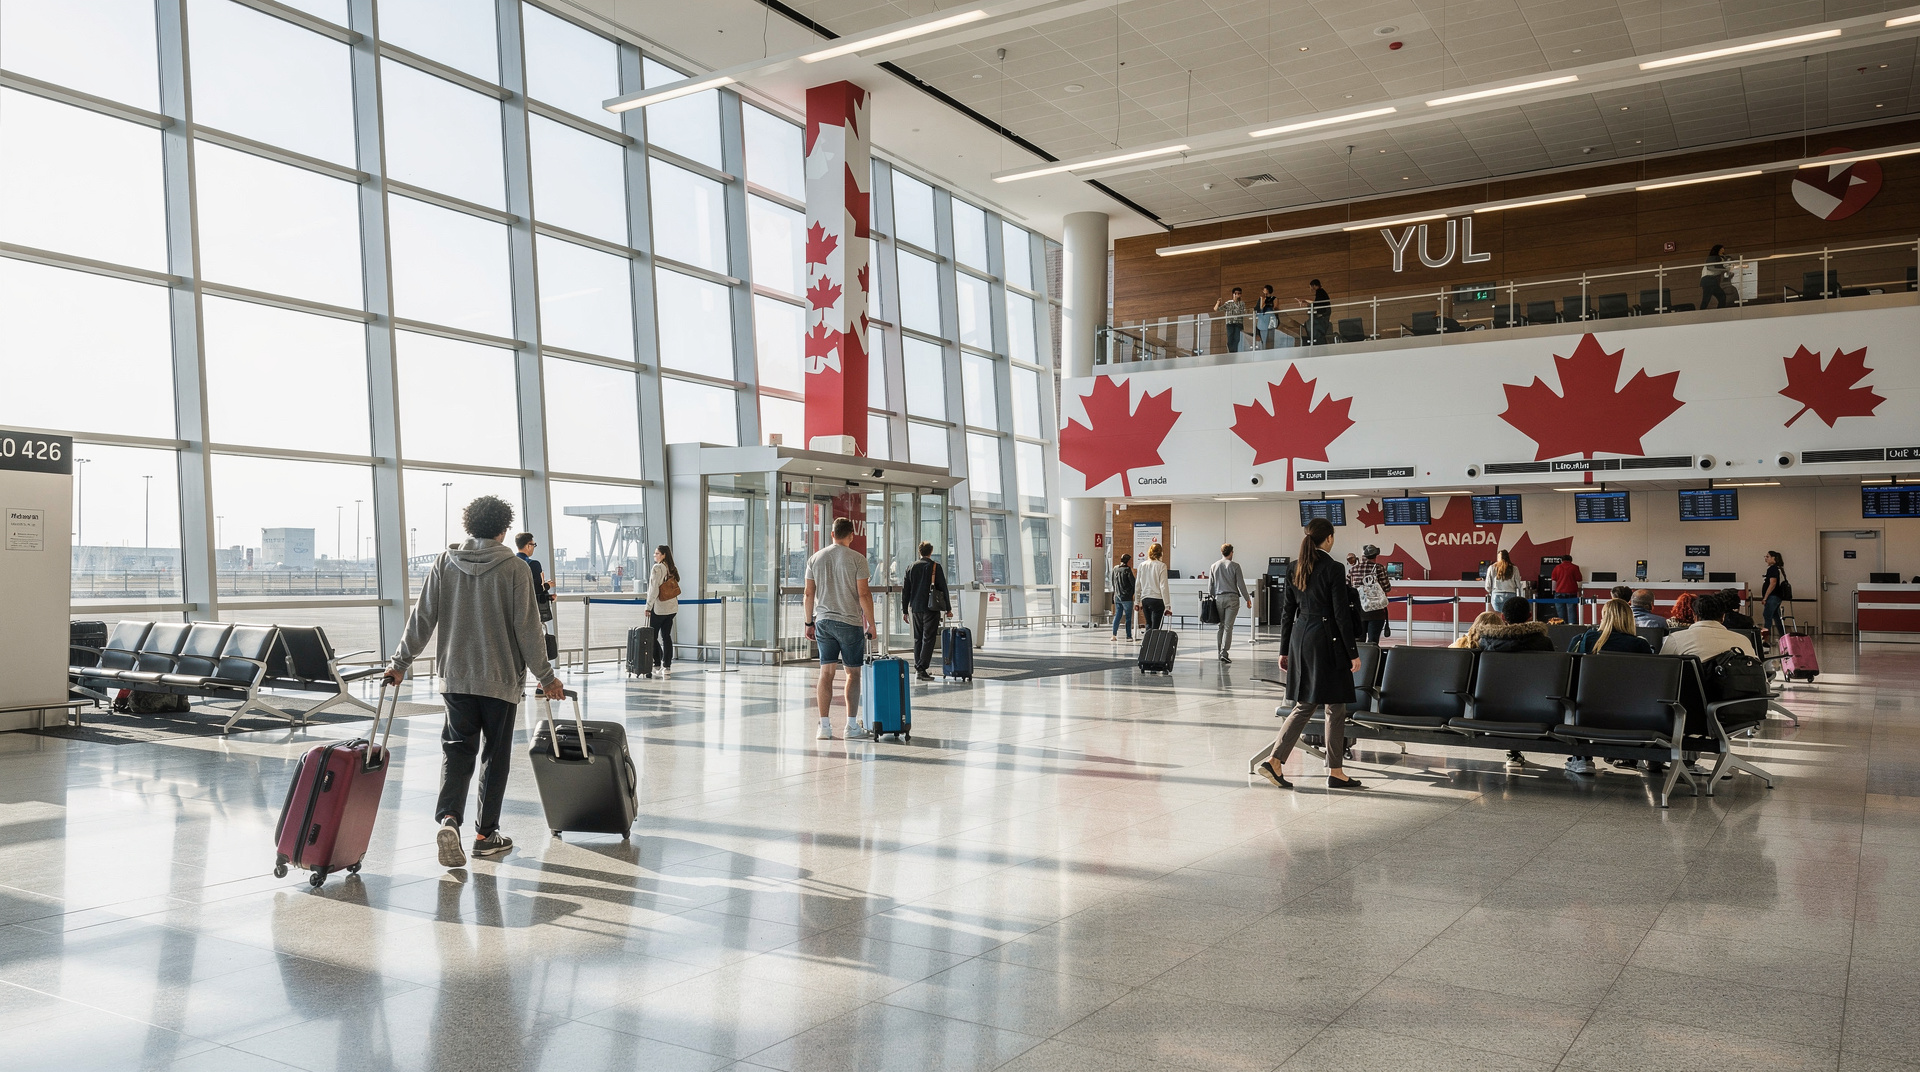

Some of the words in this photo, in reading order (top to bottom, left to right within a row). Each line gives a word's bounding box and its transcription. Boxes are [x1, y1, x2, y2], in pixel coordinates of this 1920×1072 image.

[1380, 216, 1491, 272] YUL
[21, 440, 61, 461] 426
[1138, 476, 1167, 485] Canada
[1424, 531, 1497, 546] CANADA
